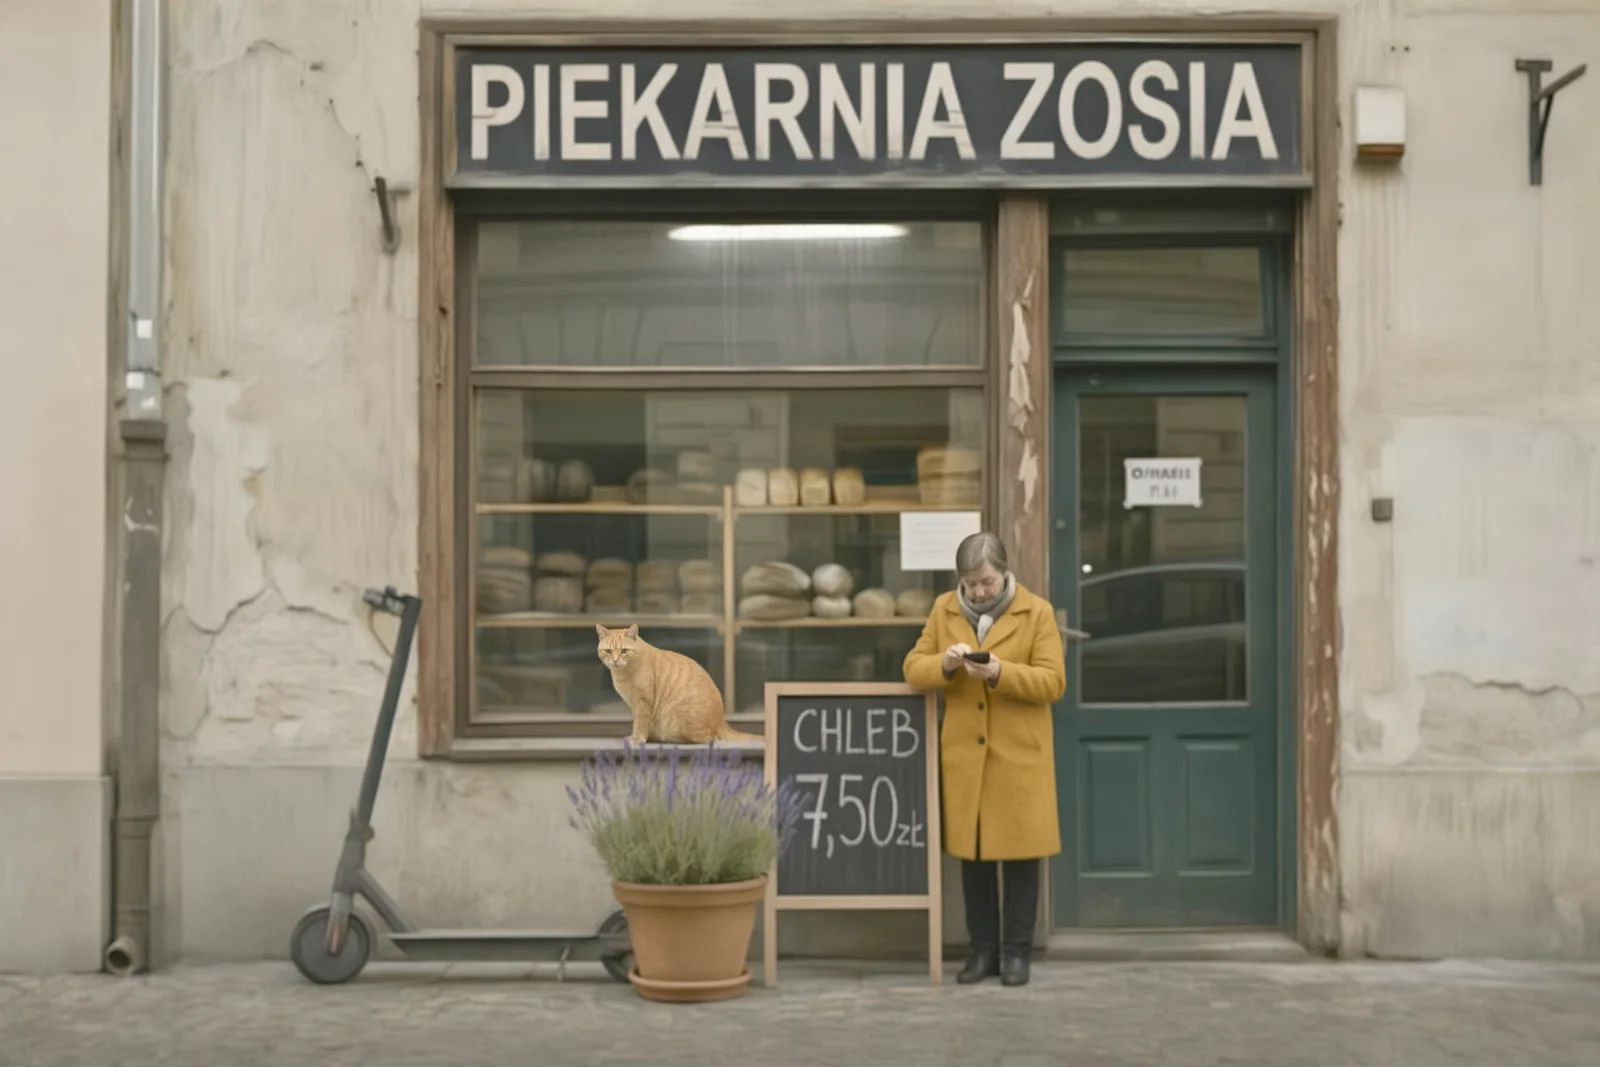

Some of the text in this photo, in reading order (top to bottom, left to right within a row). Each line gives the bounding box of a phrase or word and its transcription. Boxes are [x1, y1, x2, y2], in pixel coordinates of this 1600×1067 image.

[471, 60, 1279, 161] PIEKARNIA ZOSIA
[793, 708, 919, 758] CHLEB
